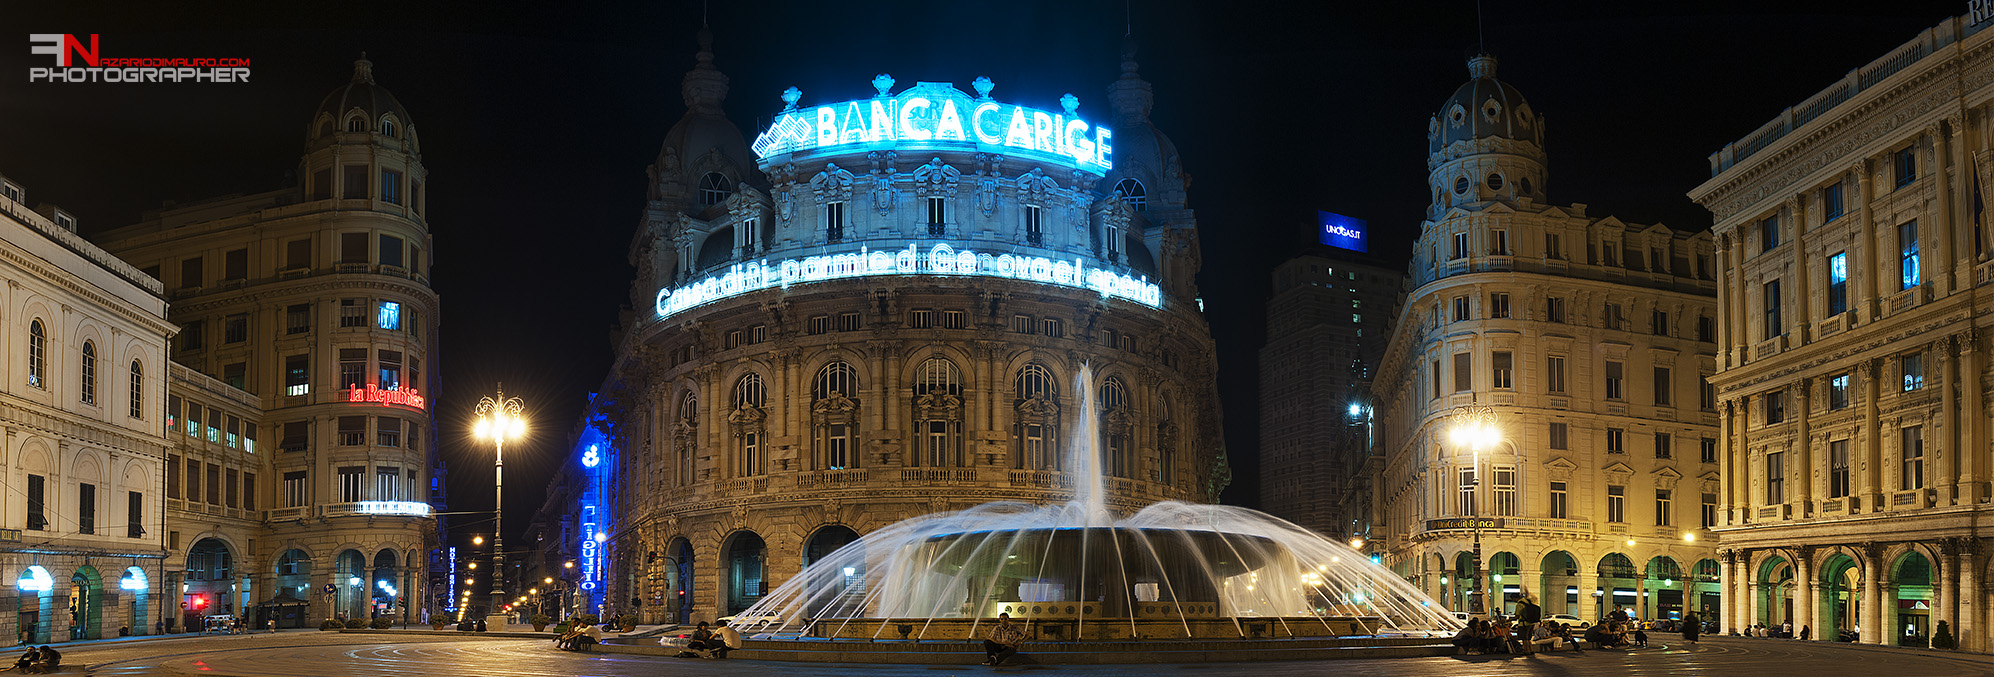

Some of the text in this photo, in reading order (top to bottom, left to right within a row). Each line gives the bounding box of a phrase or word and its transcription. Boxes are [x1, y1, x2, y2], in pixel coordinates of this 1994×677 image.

[817, 97, 1113, 170] BANCA CARIGE
[747, 244, 889, 290] Riparmio
[929, 243, 1050, 281] Genova
[349, 382, 425, 410] la Repubblica
[1437, 519, 1495, 529] UniCredit Bnca
